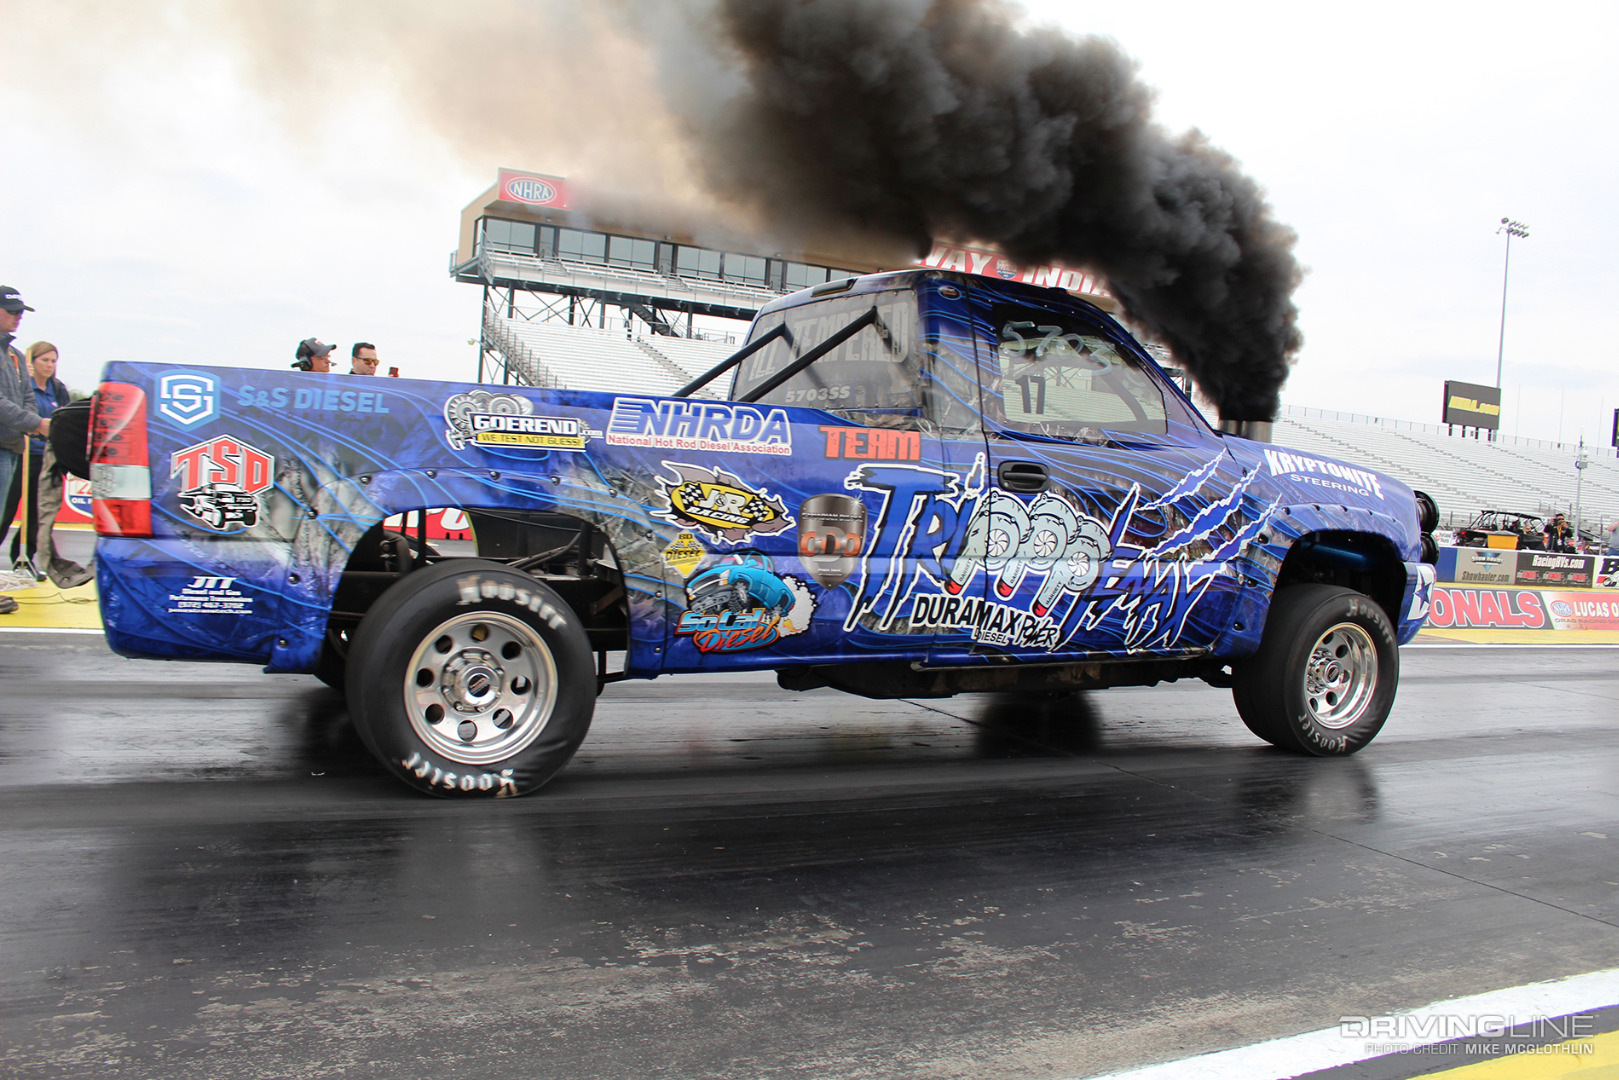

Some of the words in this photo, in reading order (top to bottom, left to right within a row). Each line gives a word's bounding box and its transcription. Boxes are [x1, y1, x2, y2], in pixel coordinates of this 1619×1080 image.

[513, 182, 551, 200] NHRA
[236, 385, 289, 408] S&S
[294, 388, 390, 414] DIESEL
[785, 385, 850, 403] 5703SS
[1015, 375, 1046, 415] 17
[474, 415, 578, 435] GOEREND
[612, 399, 790, 444] NHRDA
[482, 434, 496, 442] WE
[500, 435, 522, 443] TEST
[525, 436, 544, 444] NOT
[608, 434, 652, 445] National
[655, 438, 674, 448] Hot
[676, 439, 696, 449] Rod
[700, 440, 731, 451] Diesel
[734, 442, 790, 455] Association
[820, 426, 921, 460] TEAM
[171, 434, 275, 495] TSD
[1263, 449, 1385, 501] KRYPTONITE
[1290, 474, 1370, 497] STEERING
[698, 488, 747, 515] J&R
[685, 506, 750, 524] RACING
[665, 548, 701, 561] DIESEL
[1532, 555, 1586, 569] RacingRVs.com
[1461, 571, 1510, 583] Showhauler.com
[912, 596, 1020, 636] DURAMAX
[1573, 601, 1610, 618] LUCAS
[694, 616, 780, 652] Diesel
[974, 628, 1008, 644] DIESEL
[400, 752, 518, 798] Hoosier
